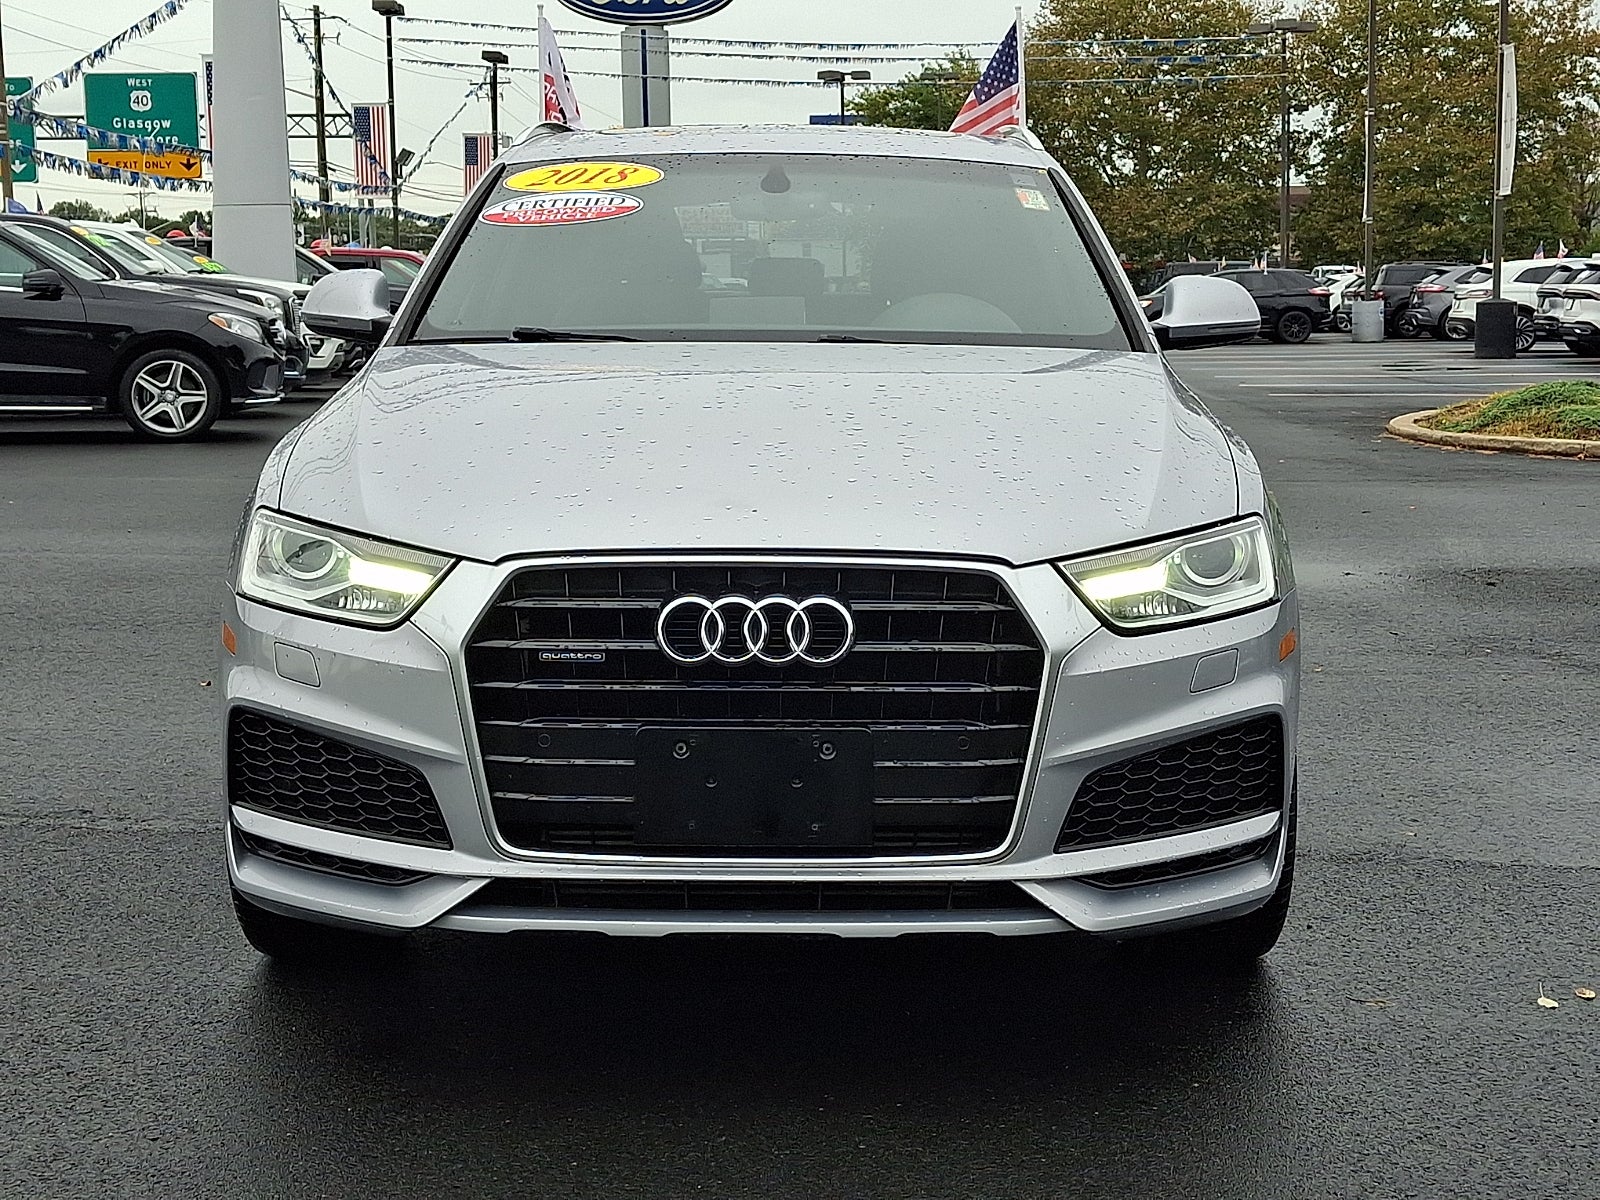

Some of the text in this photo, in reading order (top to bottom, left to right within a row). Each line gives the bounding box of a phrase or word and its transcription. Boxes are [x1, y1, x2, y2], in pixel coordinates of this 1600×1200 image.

[127, 78, 153, 87] WEST
[132, 95, 149, 107] 40
[113, 117, 171, 132] Glasgow
[116, 160, 171, 169] EXIT ONLY
[525, 168, 640, 187] 2018
[502, 197, 626, 212] CERTIFIED
[502, 205, 618, 219] PRE-OWNED
[518, 211, 598, 223] VEHICLE
